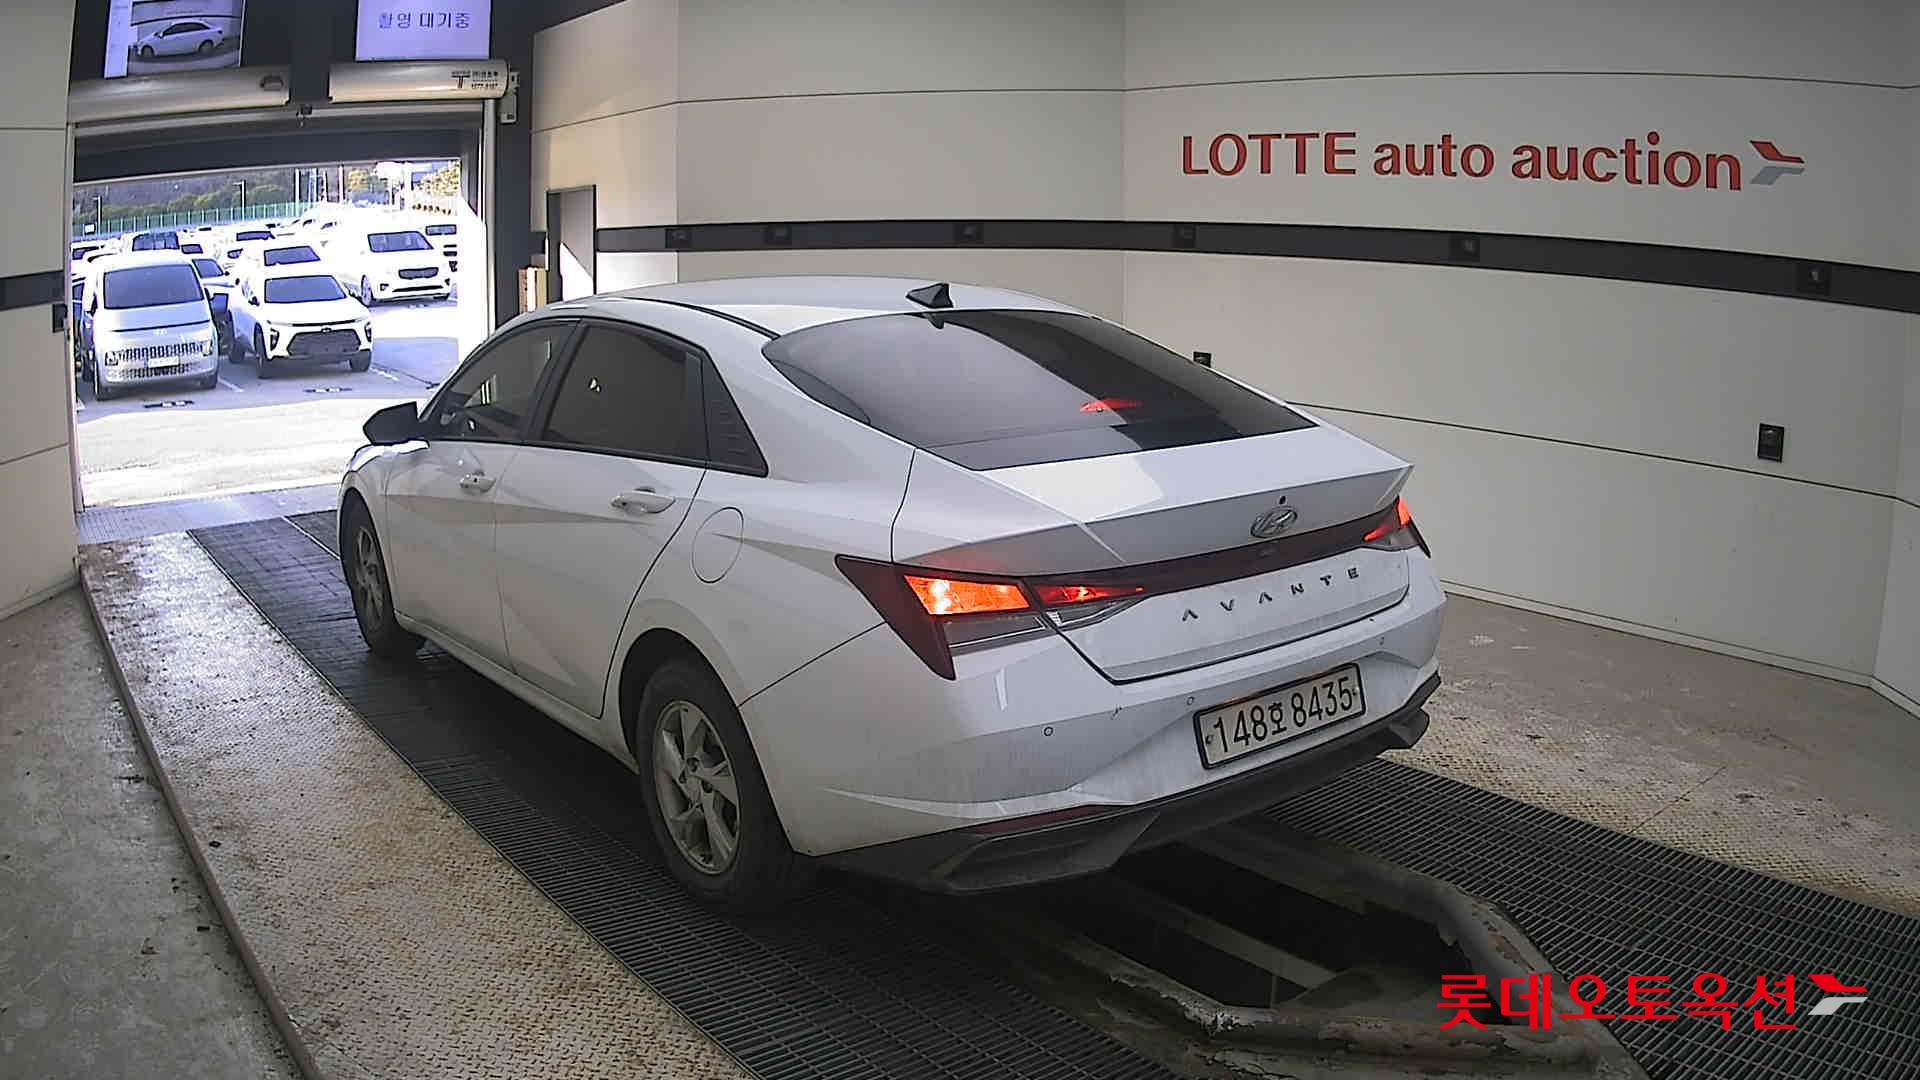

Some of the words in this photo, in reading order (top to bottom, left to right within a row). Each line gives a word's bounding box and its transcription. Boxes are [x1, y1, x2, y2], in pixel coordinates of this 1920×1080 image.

[420, 12, 470, 29] 대기중
[1182, 132, 1357, 176] LOTTE
[1374, 134, 1495, 177] auto
[1511, 131, 1742, 191] auction
[1182, 567, 1360, 622] AVANTE
[1291, 676, 1353, 727] 8435
